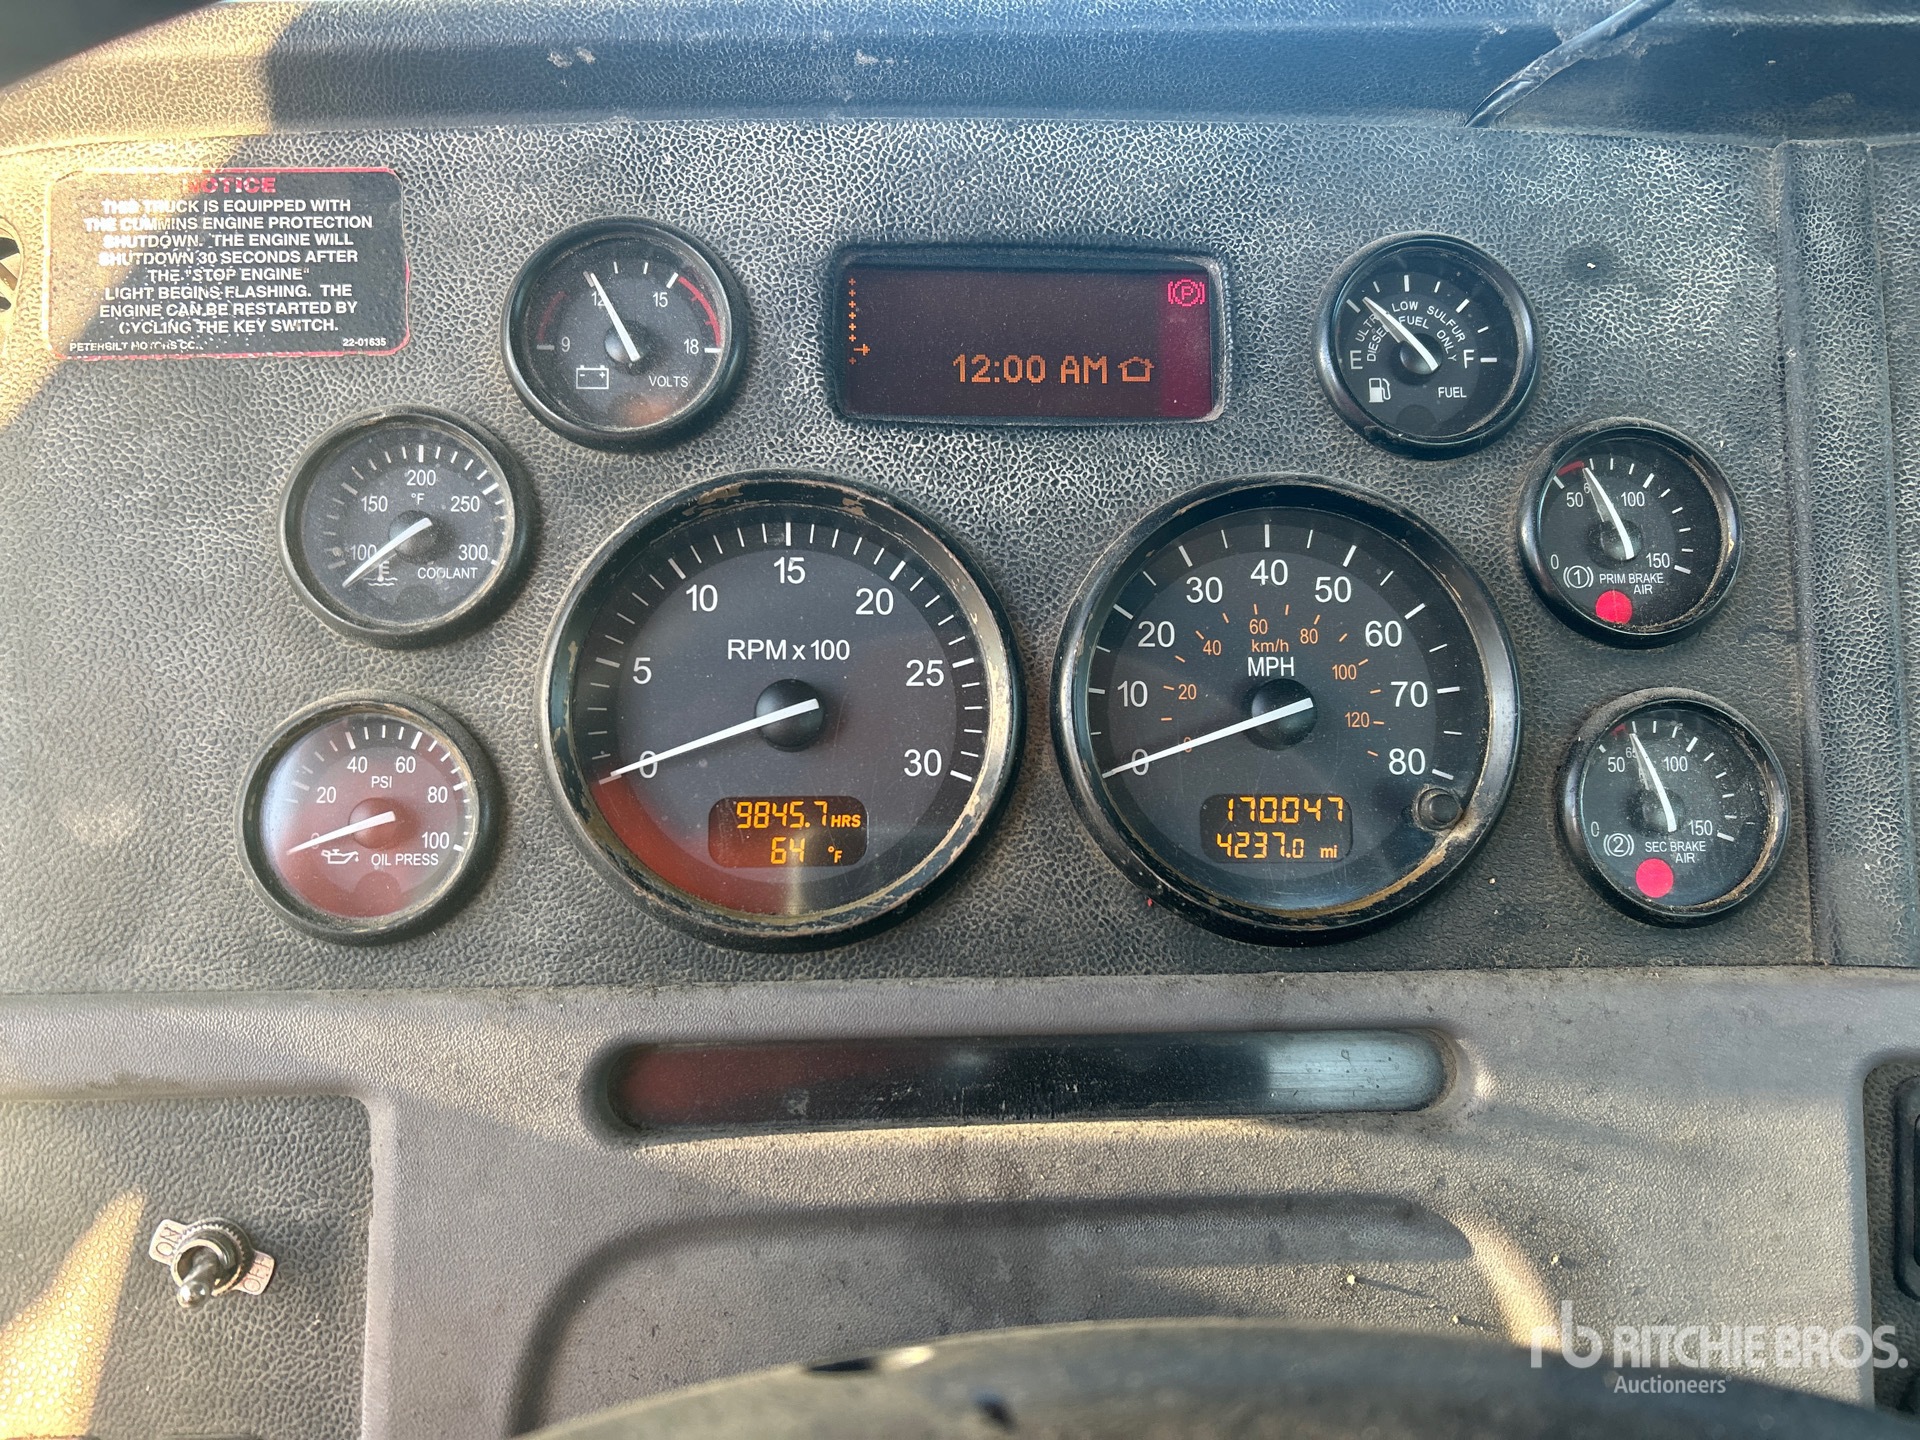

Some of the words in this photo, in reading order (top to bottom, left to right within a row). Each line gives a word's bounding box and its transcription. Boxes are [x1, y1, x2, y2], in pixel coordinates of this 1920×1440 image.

[182, 177, 276, 193] NOTICE
[101, 199, 139, 214] THIS
[142, 199, 199, 213] TRUCK
[204, 200, 219, 213] IS
[223, 199, 306, 213] EQUIPPED
[310, 199, 351, 212] WITH
[83, 217, 117, 232] THE
[120, 217, 198, 231] CUMMINS
[203, 217, 264, 230] ENGINE
[268, 215, 373, 229] PROTECTION
[103, 234, 203, 248] SHUTDOWN.
[213, 234, 244, 247] THE
[249, 233, 310, 246] ENGINE
[315, 233, 354, 246] WILL
[98, 251, 194, 266] SHUTDOWN
[199, 252, 217, 264] 30
[221, 251, 301, 264] SECONDS
[305, 250, 358, 263] AFTER
[105, 287, 155, 300] LIGHT
[158, 286, 220, 300] BEGINS
[225, 285, 312, 298] FLASHING.
[320, 284, 352, 297] THE
[653, 292, 668, 307] 15
[100, 304, 161, 318] ENGINE
[166, 303, 200, 317] CAN
[206, 303, 229, 316] BE
[233, 302, 332, 316] RESTARTED
[336, 301, 358, 314] BY
[119, 321, 192, 335] CYCLING
[198, 321, 229, 334] THE
[234, 319, 267, 333] KEY
[271, 319, 339, 332] SWITCH.
[1355, 313, 1379, 342] ULTR
[1391, 301, 1418, 313] LOW
[1426, 305, 1466, 342] SULFUR
[342, 338, 387, 347] 22-01635
[561, 337, 571, 352] 9
[684, 338, 699, 354] 18
[1366, 325, 1389, 362] DIESE
[1399, 315, 1429, 330] FUEL
[1436, 330, 1459, 362] ONLY
[1350, 350, 1363, 370] E
[1463, 349, 1475, 369] F
[952, 354, 1046, 384] 12:00
[1060, 355, 1108, 384] AM
[649, 376, 689, 388] VOLTS
[1438, 386, 1467, 398] FUEL
[406, 470, 436, 486] 200
[361, 495, 388, 512] 150
[450, 495, 480, 512] 250
[1566, 491, 1584, 507] 50
[1621, 491, 1645, 507] 100
[351, 544, 377, 560] 100
[458, 544, 488, 560] 300
[1645, 552, 1670, 568] 150
[1550, 554, 1559, 569] 0
[417, 567, 478, 579] COOLANT
[773, 557, 806, 584] 15
[1250, 559, 1289, 586] 40
[1600, 573, 1626, 584] PRIM
[1628, 573, 1664, 584] BRAKE
[686, 584, 718, 612] 10
[1185, 577, 1223, 603] 30
[1314, 576, 1352, 603] 50
[1633, 584, 1653, 595] AIR
[855, 588, 894, 615] 20
[1138, 620, 1175, 648] 20
[1249, 618, 1268, 634] 60
[1364, 621, 1402, 648] 60
[1299, 628, 1319, 644] 80
[727, 640, 788, 660] RPM
[792, 646, 806, 660] x
[811, 640, 850, 660] 100
[1202, 640, 1222, 655] 40
[1251, 638, 1289, 653] km/h
[632, 657, 652, 684] 5
[905, 660, 945, 687] 25
[1248, 656, 1295, 677] MPH
[1332, 664, 1357, 680] 100
[1117, 680, 1148, 708] 10
[1178, 684, 1197, 700] 20
[1390, 680, 1428, 708] 70
[1344, 711, 1370, 728] 120
[347, 756, 368, 773] 40
[395, 756, 416, 773] 60
[639, 751, 658, 778] 0
[904, 749, 942, 776] 30
[1132, 748, 1150, 776] 0
[1388, 748, 1426, 775] 80
[1607, 756, 1625, 773] 50
[1663, 756, 1688, 772] 100
[371, 776, 393, 788] PSI
[316, 786, 337, 803] 20
[427, 786, 448, 803] 80
[736, 801, 828, 829] 9845.7
[831, 815, 861, 828] HRS
[1227, 796, 1344, 823] 170047
[1590, 822, 1599, 837] 0
[1688, 820, 1713, 836] 150
[421, 832, 450, 849] 100
[1216, 831, 1305, 859] 4237.0
[1319, 844, 1338, 859] mi
[1645, 842, 1668, 853] SEC
[1669, 841, 1706, 852] BRAKE
[771, 837, 806, 864] 64
[1675, 853, 1696, 863] AIR
[371, 853, 392, 866] OIL
[395, 853, 439, 866] PRESS
[156, 1226, 181, 1257] ON
